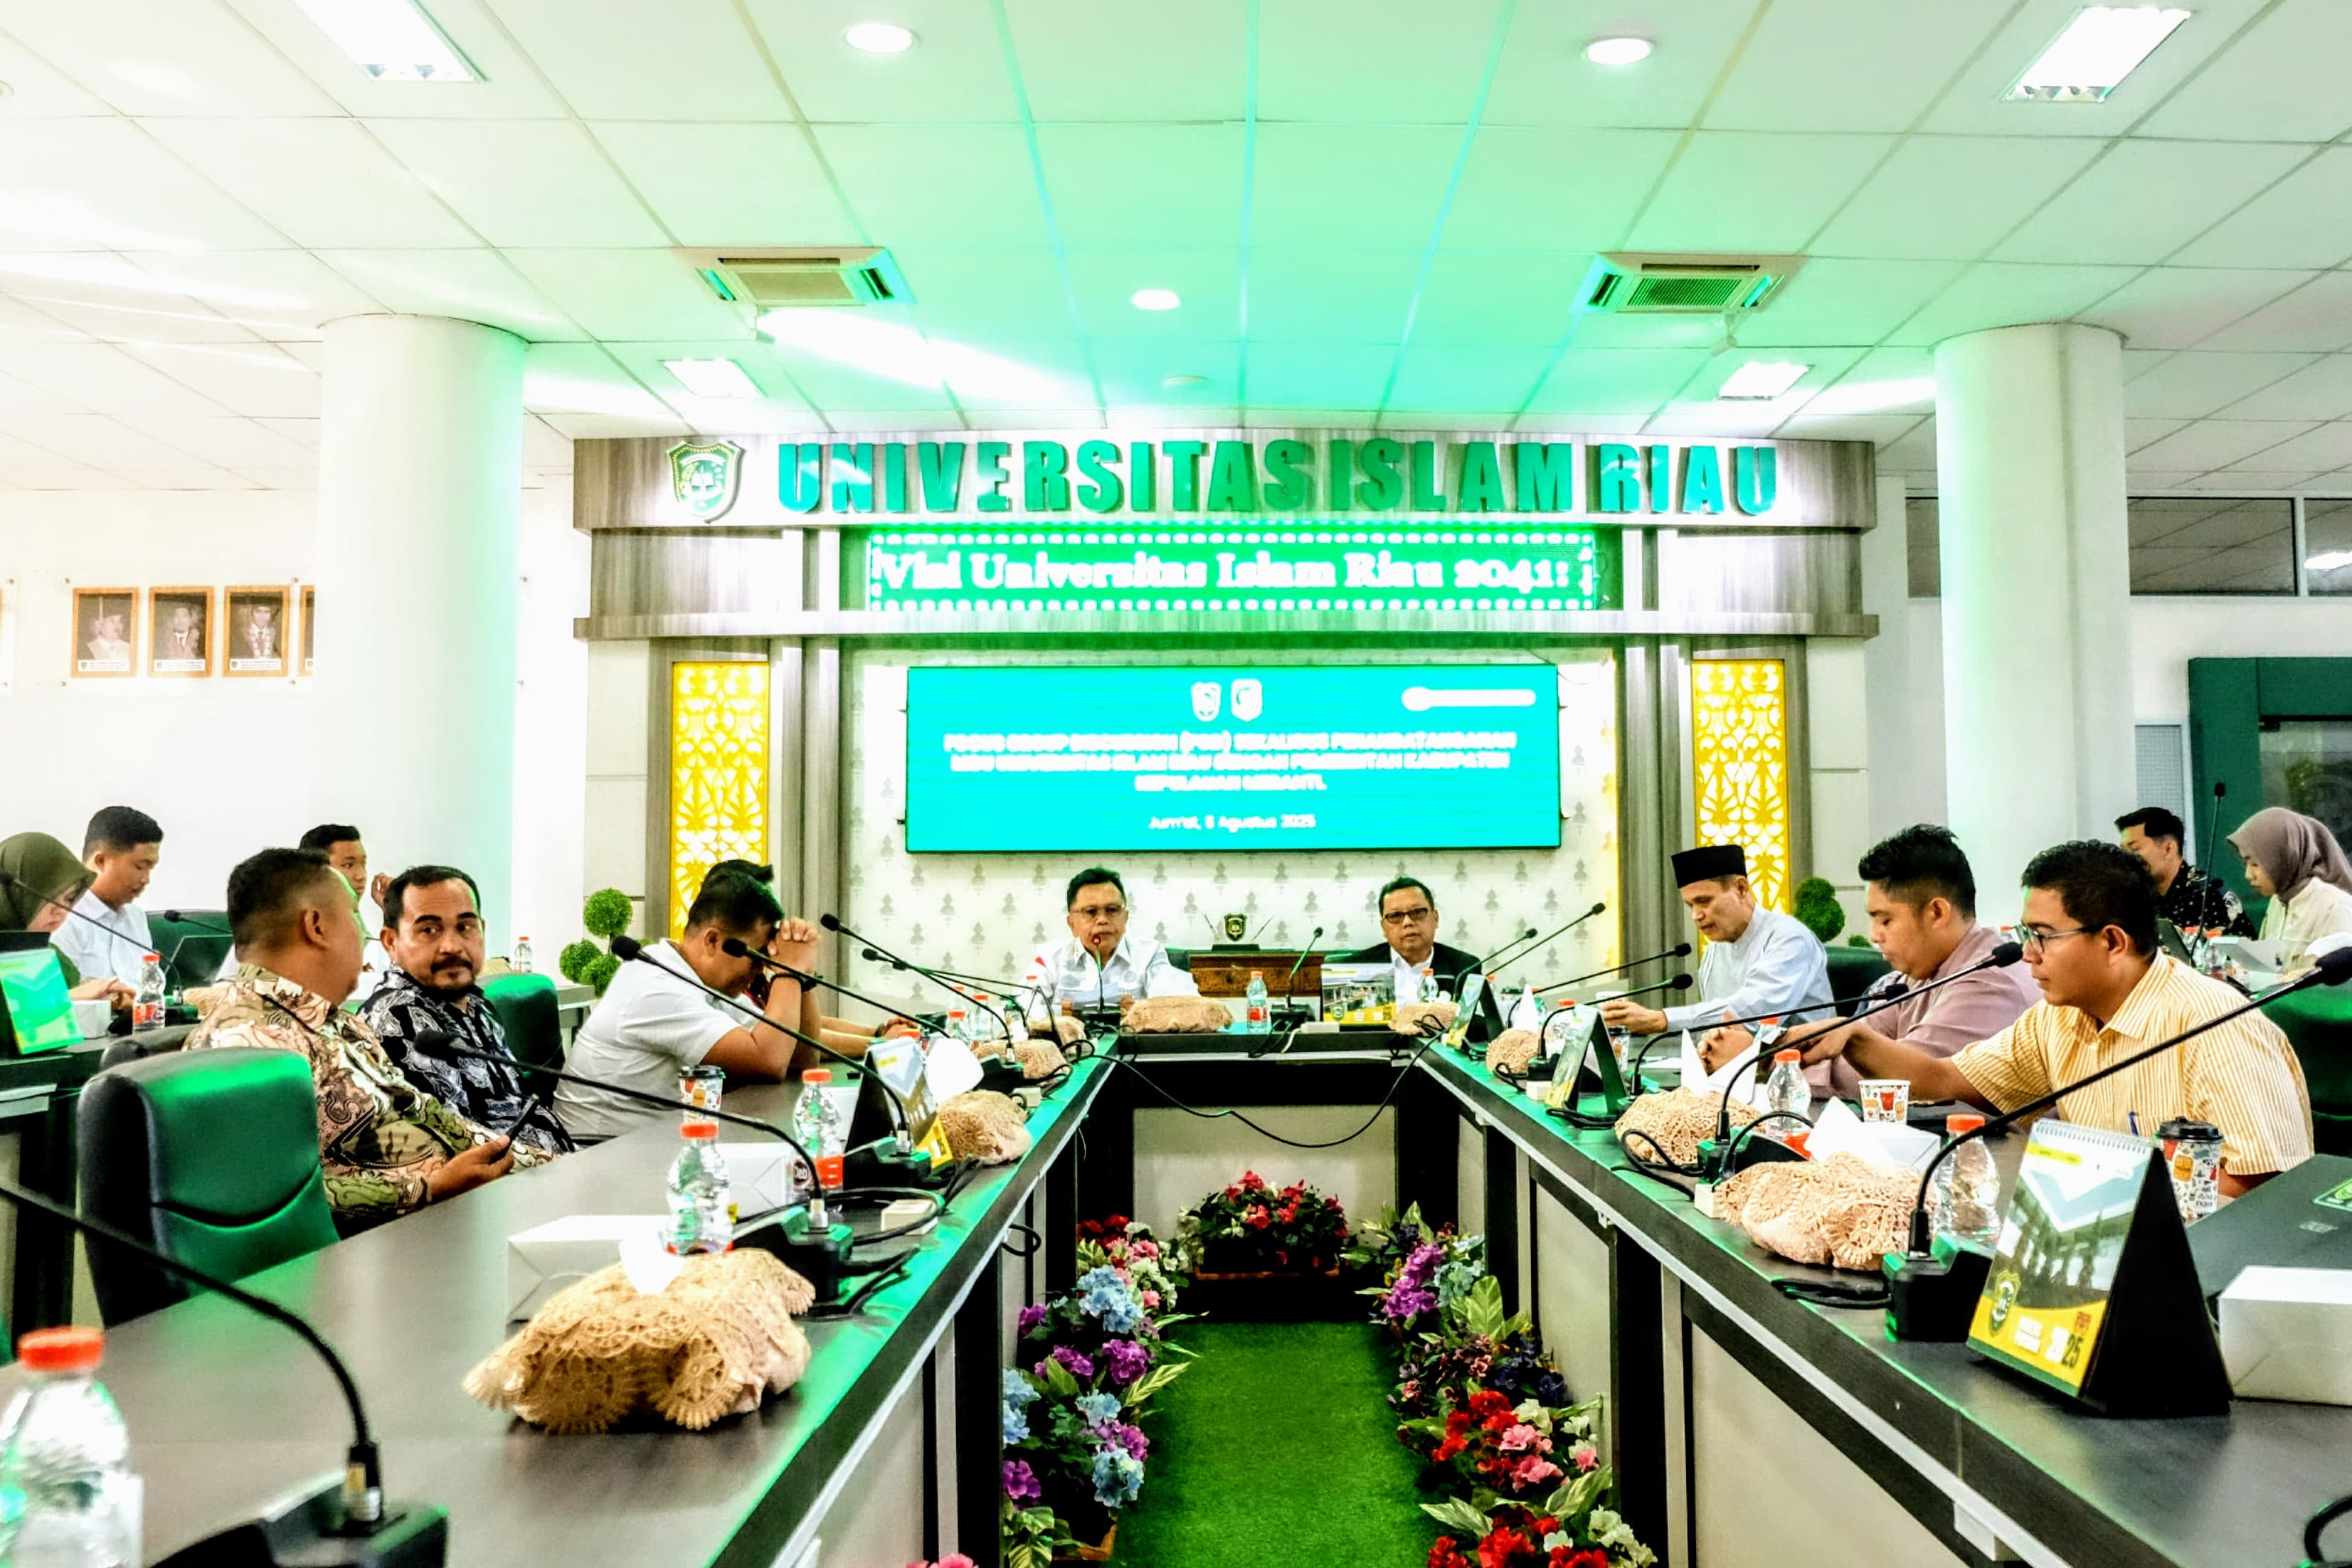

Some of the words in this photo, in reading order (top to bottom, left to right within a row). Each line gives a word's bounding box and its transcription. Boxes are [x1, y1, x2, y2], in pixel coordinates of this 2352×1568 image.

[778, 437, 1306, 514] UNIVERSITAS
[1330, 437, 1573, 512] ISLAM
[1598, 443, 1777, 515] RIAU
[876, 552, 963, 589] Visi
[969, 552, 1207, 589] Universitas
[1216, 550, 1337, 588] Islam
[1344, 550, 1443, 588] Riau
